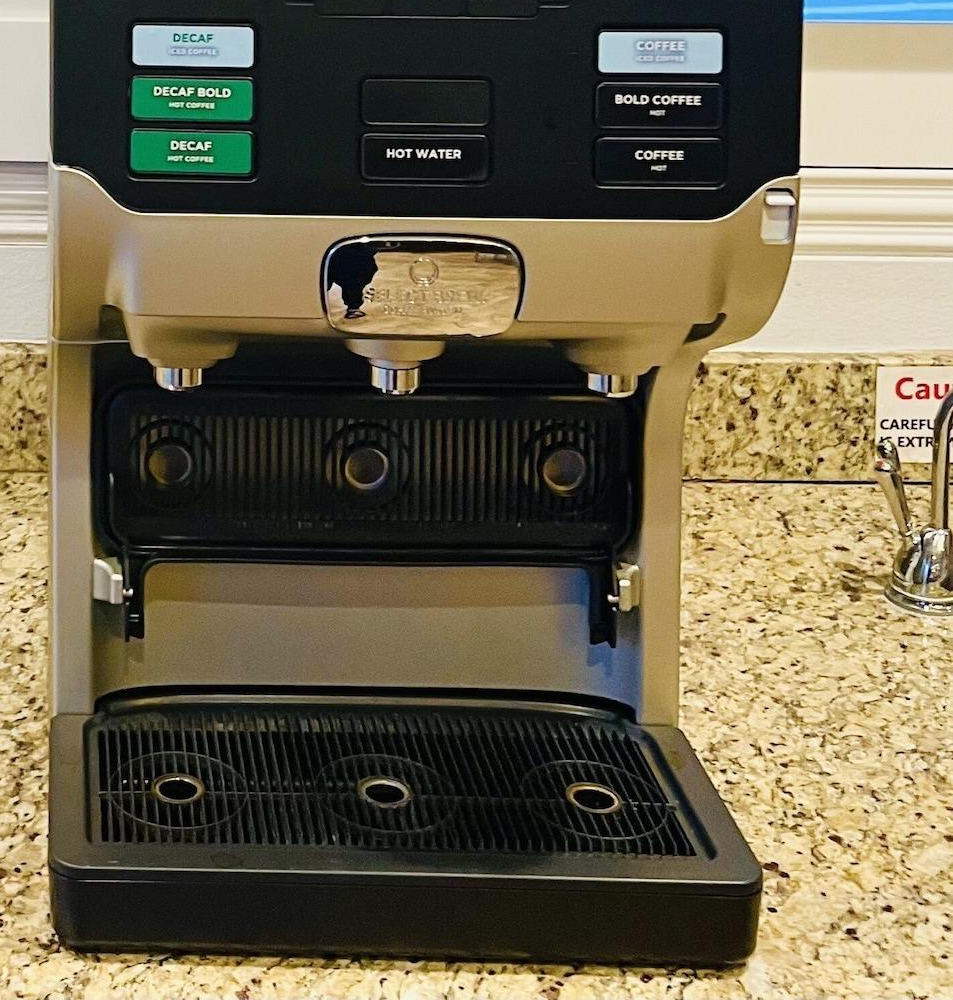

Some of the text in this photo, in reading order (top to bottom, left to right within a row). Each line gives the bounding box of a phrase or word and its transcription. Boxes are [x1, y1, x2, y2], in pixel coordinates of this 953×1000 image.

[173, 33, 214, 43] DECAF
[635, 40, 687, 51] COFFEE
[188, 47, 218, 57] COFFEE
[655, 55, 685, 63] COFFEE
[153, 86, 232, 98] DECAF BOLD
[614, 94, 702, 106] BOLD COFFEE
[168, 101, 216, 110] HOT COFFEE
[170, 141, 213, 151] DECAF
[386, 148, 462, 160] HOT WATER
[634, 150, 685, 161] COFFEE
[167, 155, 215, 164] HOT COFFEE
[898, 436, 935, 447] EXTR
